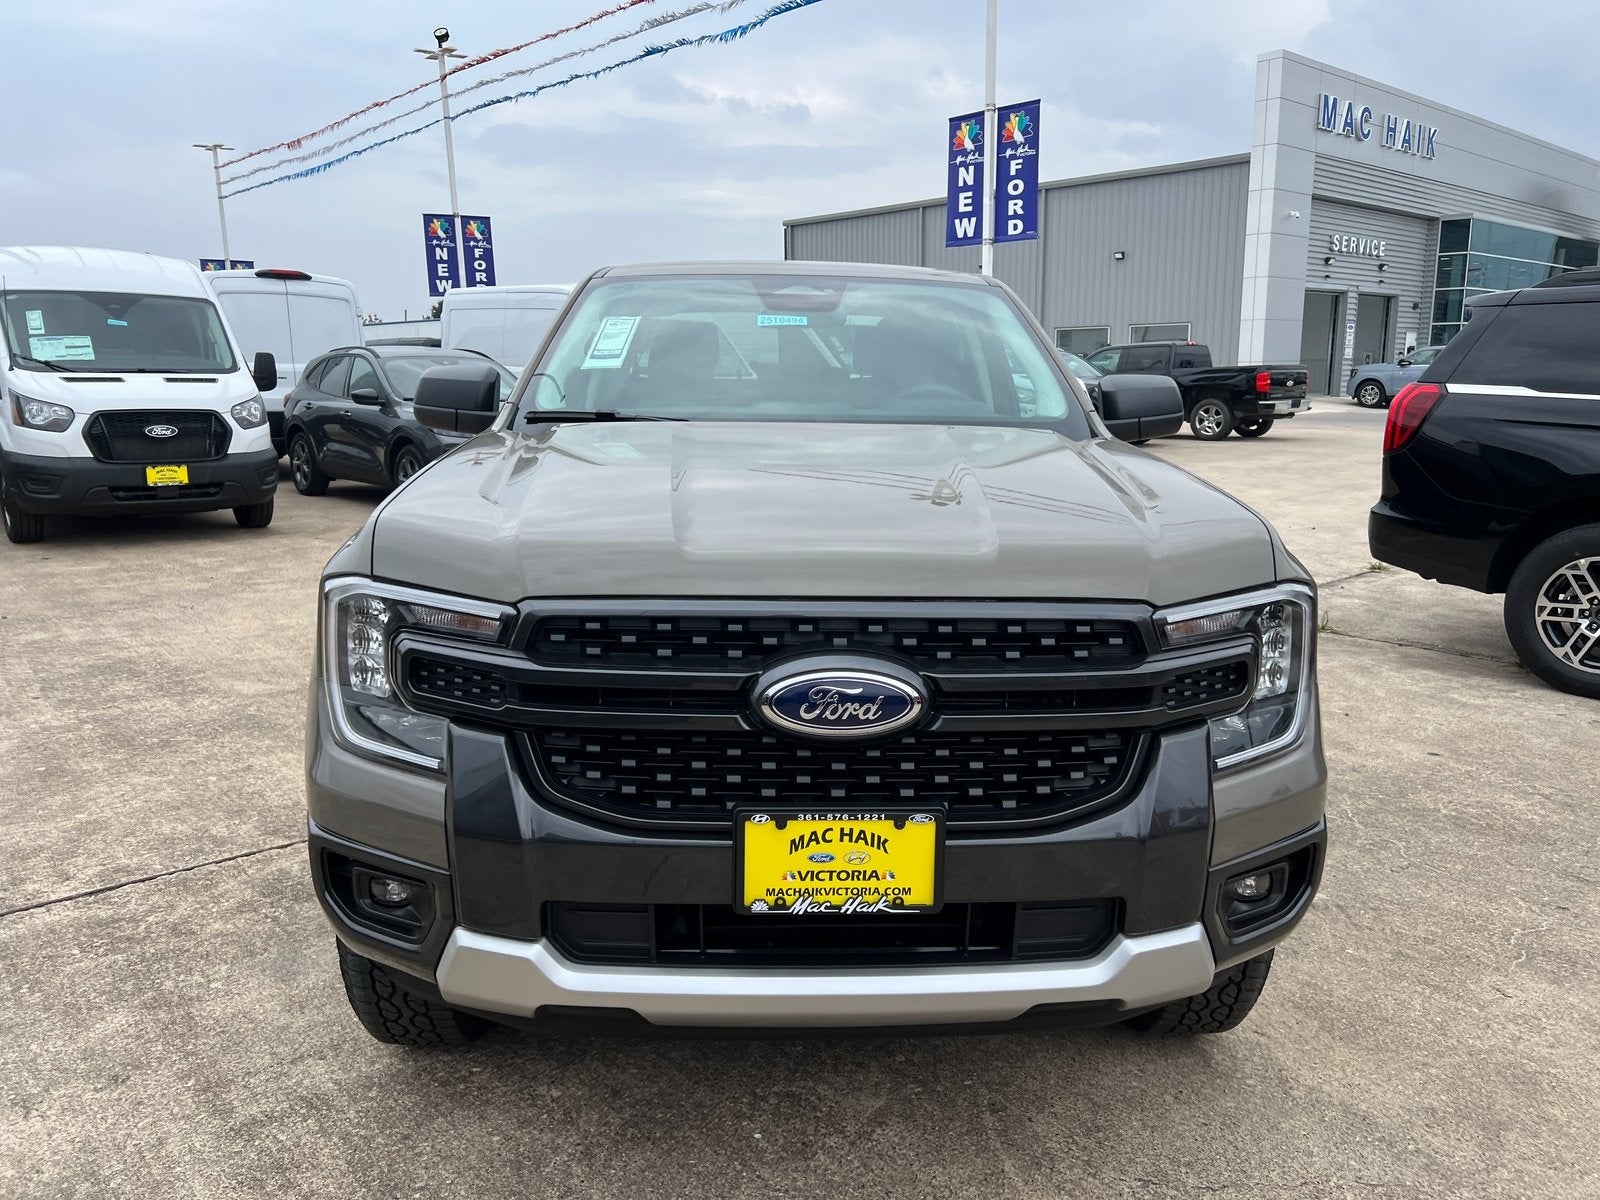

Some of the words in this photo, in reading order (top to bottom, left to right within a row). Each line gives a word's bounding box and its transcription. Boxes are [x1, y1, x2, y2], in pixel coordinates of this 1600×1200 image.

[1318, 93, 1372, 142] MAC
[1381, 113, 1440, 160] HAIK
[954, 165, 977, 239] NEW
[1007, 159, 1025, 236] FORD
[1330, 234, 1387, 257] SERVICE
[435, 247, 453, 293] NEW
[760, 316, 804, 325] 25T0494
[152, 427, 172, 435] Ford
[799, 685, 885, 721] Ford
[797, 813, 886, 821] 361-576-1221
[789, 827, 834, 856] MAC
[839, 827, 890, 855] HAIK
[797, 870, 881, 882] VICTORIA
[765, 887, 912, 897] MACHAIKVICTORIA.COM
[789, 896, 839, 915] Mac
[840, 895, 892, 915] Haik
